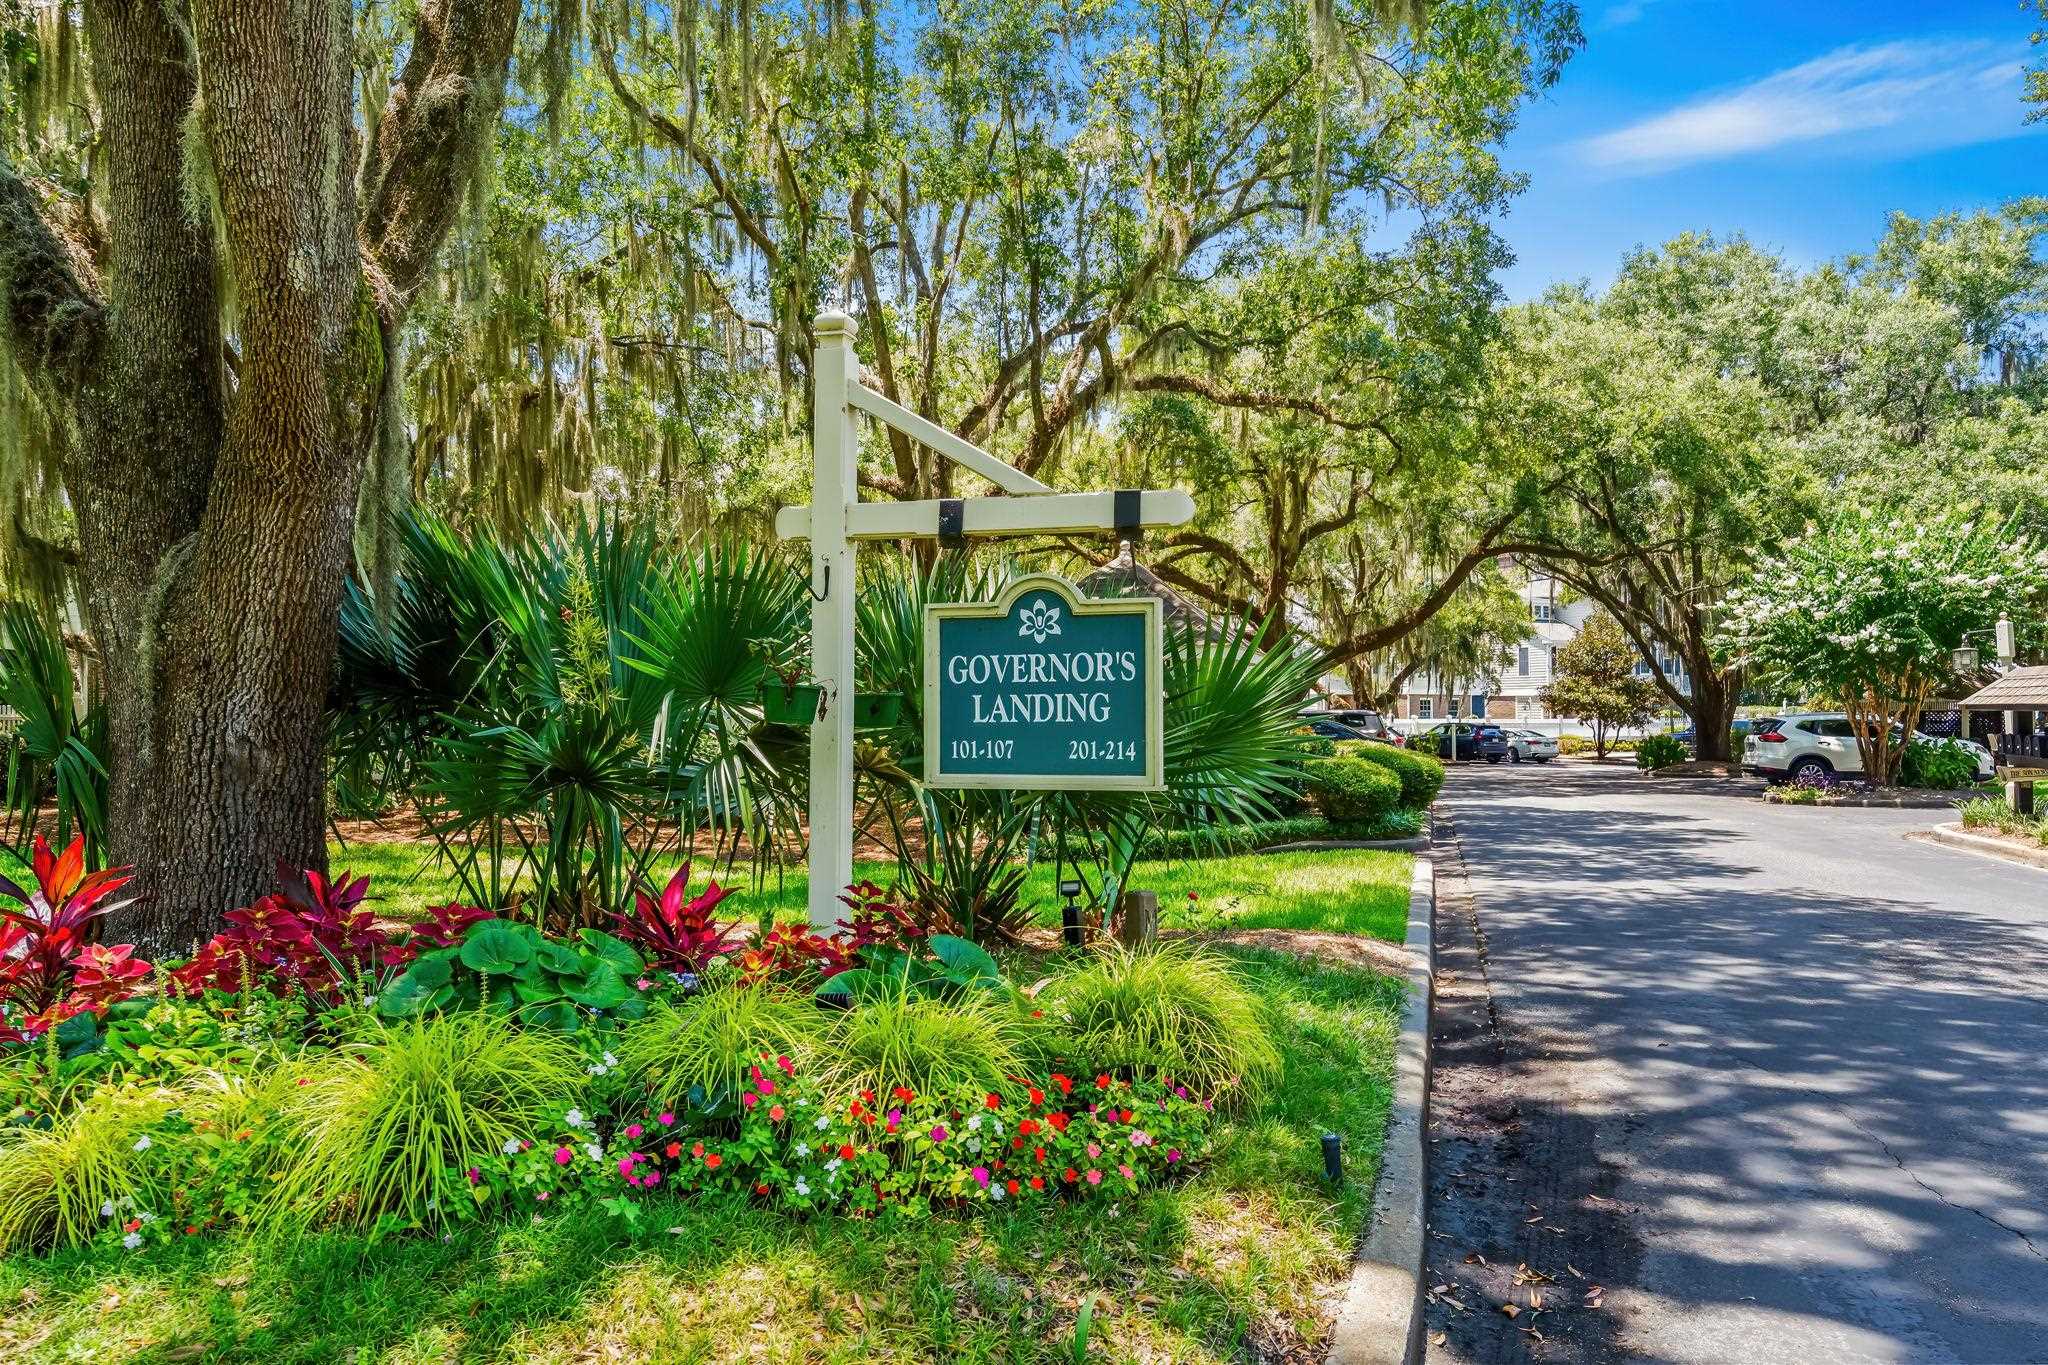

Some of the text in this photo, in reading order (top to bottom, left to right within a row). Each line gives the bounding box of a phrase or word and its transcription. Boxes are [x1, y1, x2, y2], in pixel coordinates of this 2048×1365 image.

[948, 651, 1136, 684] GOVERNOR'S
[972, 692, 1111, 724] LANDING
[951, 739, 1136, 761] 101-107 201-214
